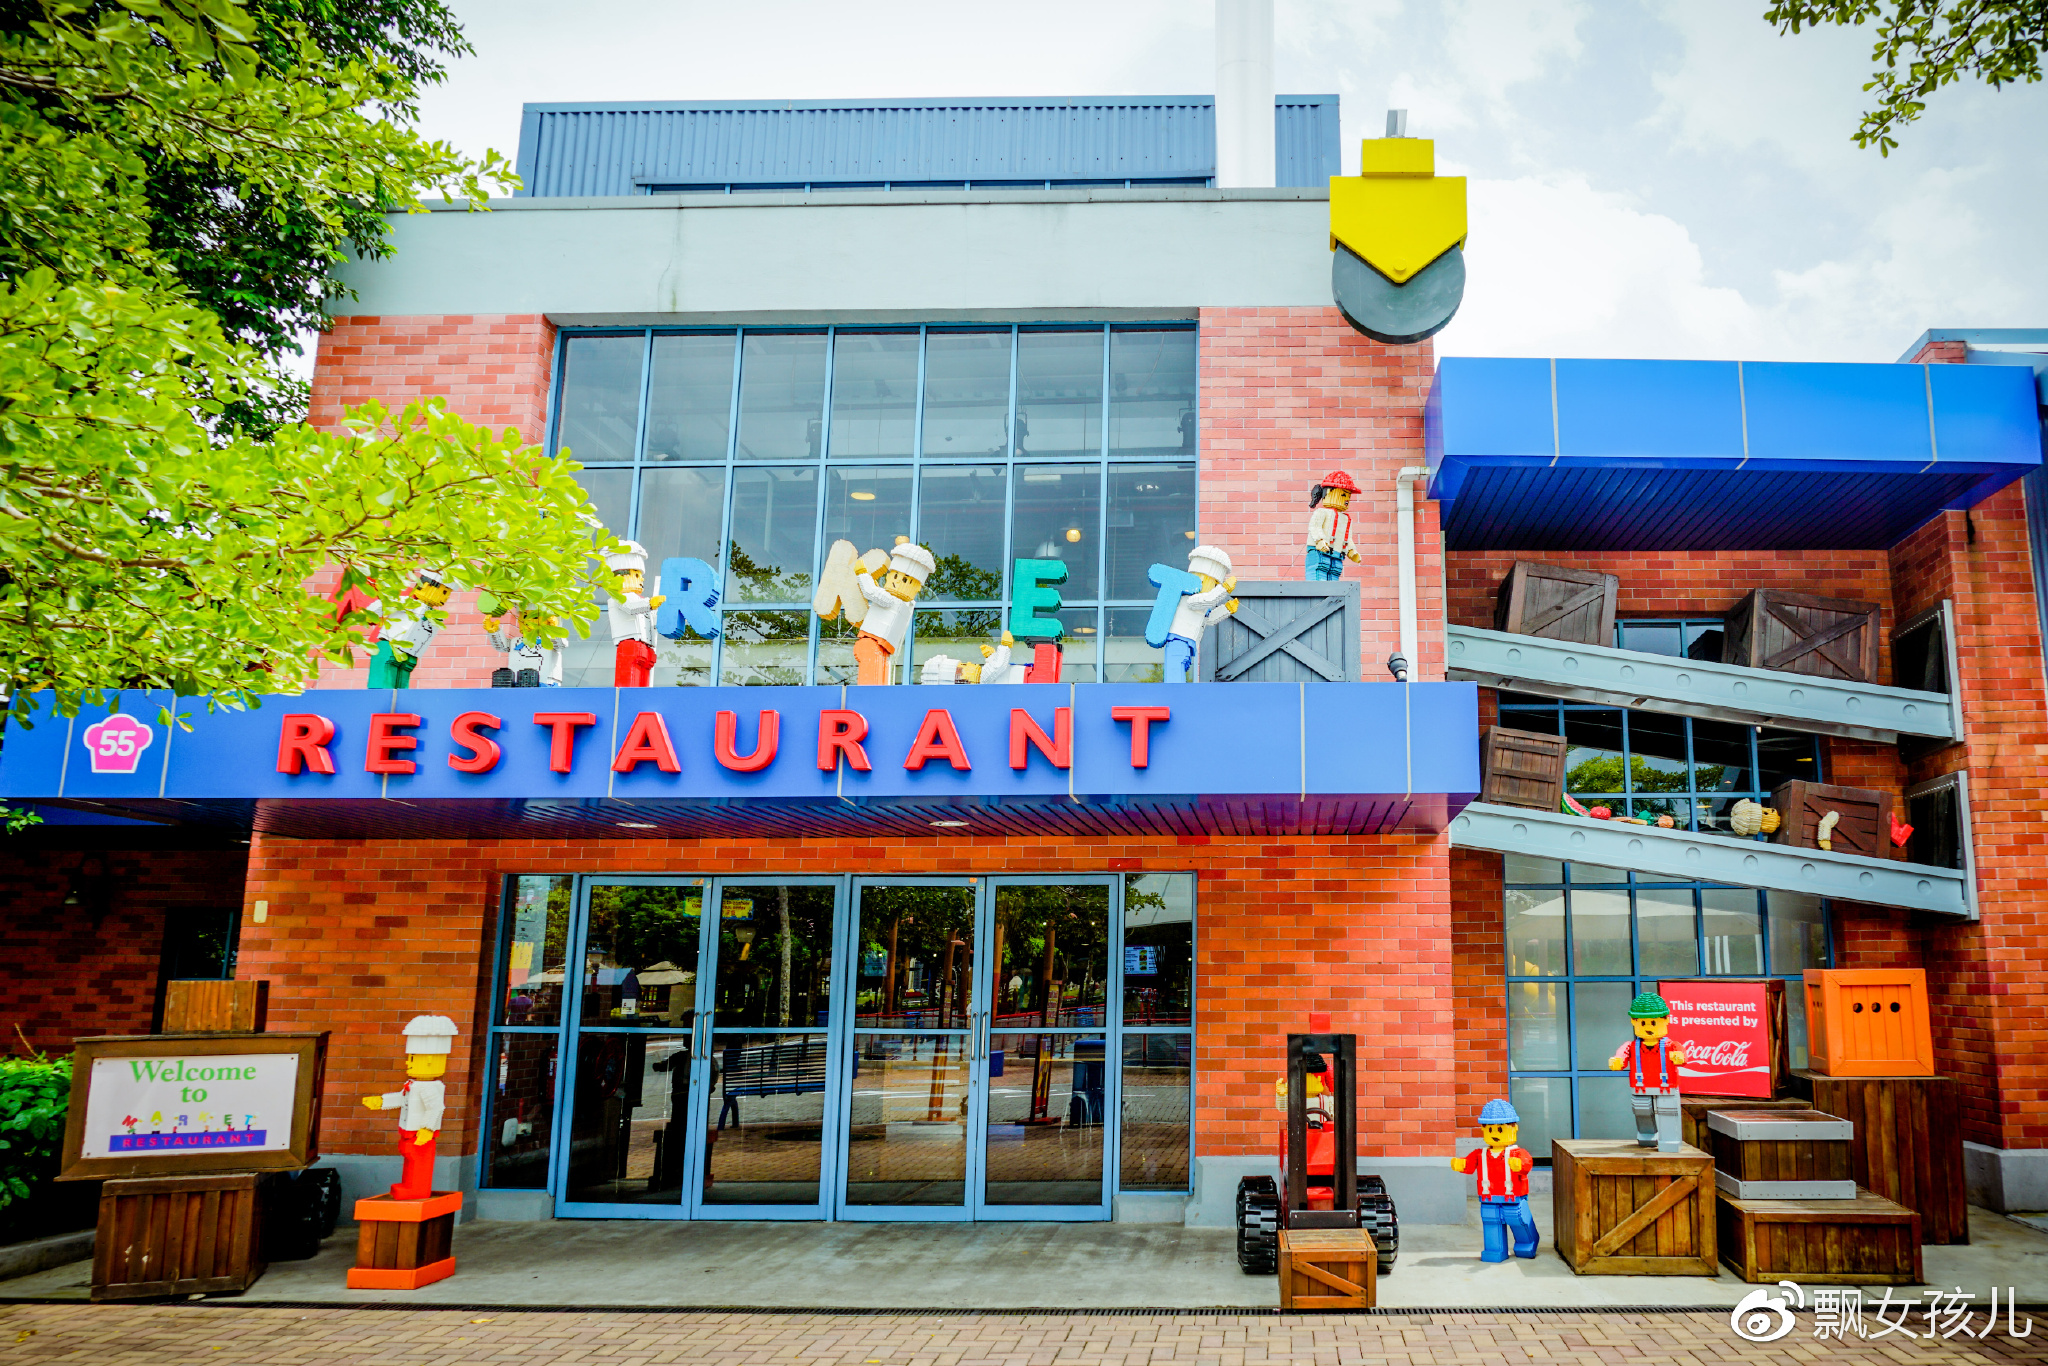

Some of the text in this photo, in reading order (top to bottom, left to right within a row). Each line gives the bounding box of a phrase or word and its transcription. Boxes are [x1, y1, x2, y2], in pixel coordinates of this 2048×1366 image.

[98, 730, 137, 756] 55
[276, 703, 1170, 775] RESTAURANT
[1669, 1000, 1757, 1012] This restaurant
[1669, 1014, 1758, 1028] is presented by
[128, 1060, 256, 1083] Welcome
[180, 1086, 208, 1103] to
[122, 1110, 255, 1127] MARKET
[122, 1133, 255, 1148] RESTAURANT
